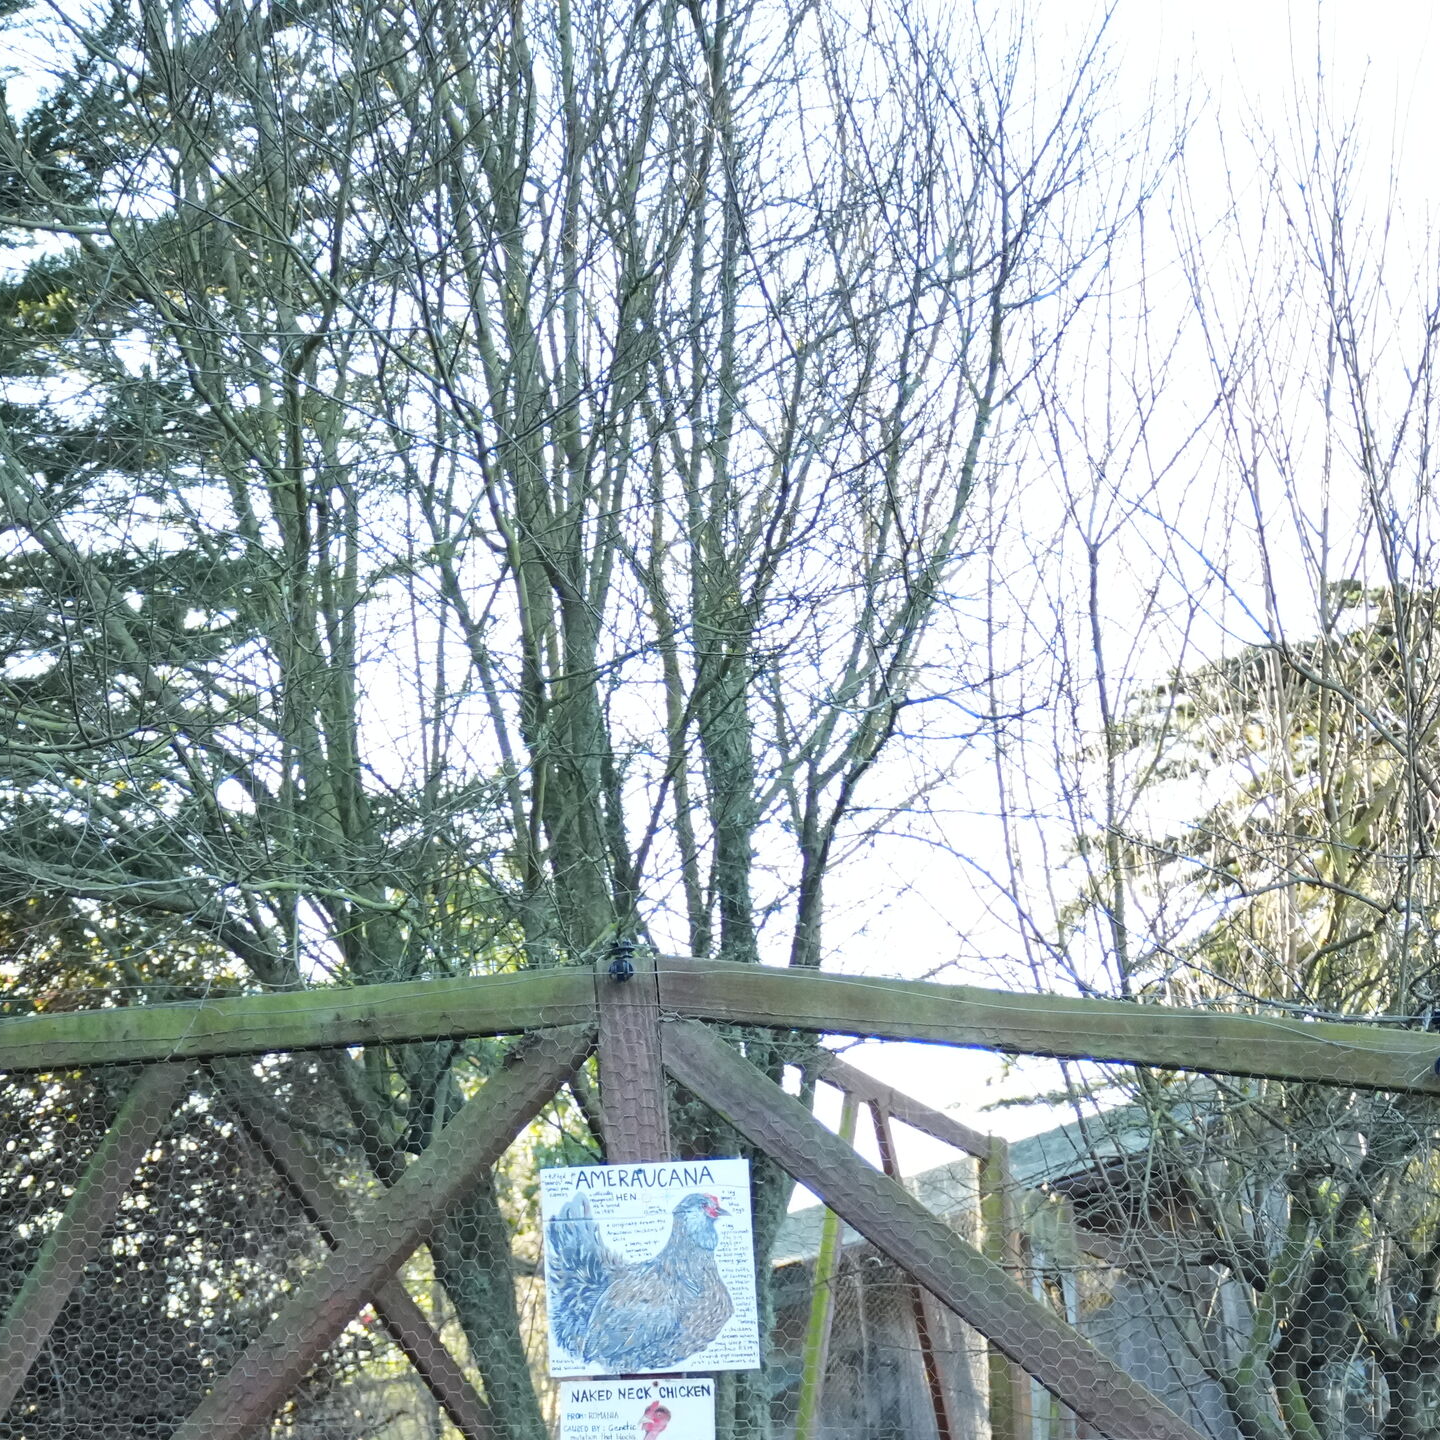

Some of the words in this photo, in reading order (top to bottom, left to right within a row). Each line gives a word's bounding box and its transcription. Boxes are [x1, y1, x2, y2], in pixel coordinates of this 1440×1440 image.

[575, 1165, 715, 1190] AMERAUCANA
[615, 1192, 637, 1201] HEN
[571, 1389, 613, 1403] NAKED
[617, 1386, 652, 1400] NECK
[659, 1384, 711, 1399] CHICKEN
